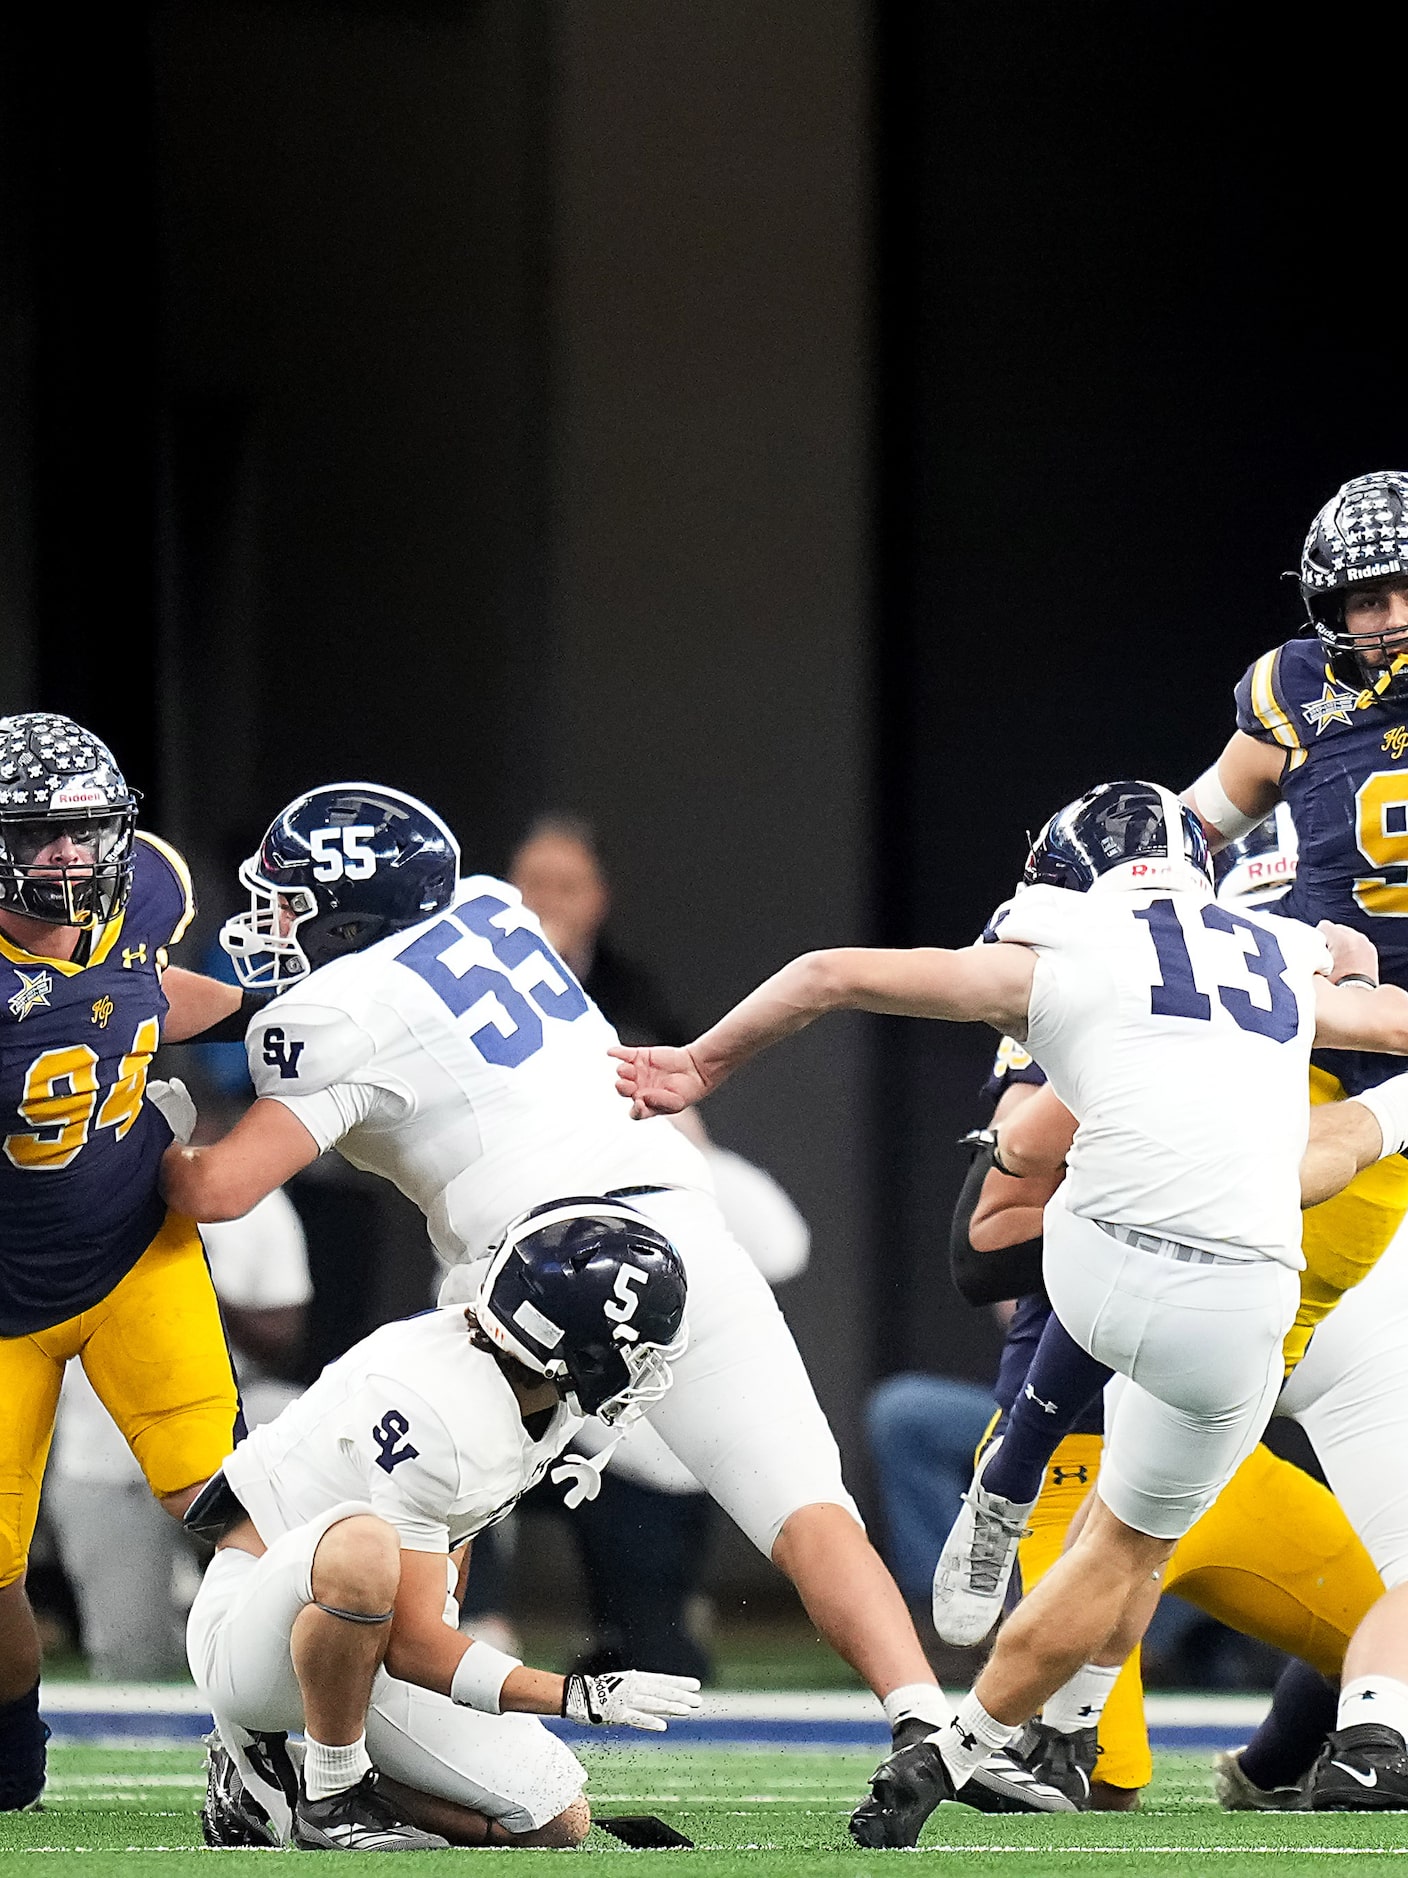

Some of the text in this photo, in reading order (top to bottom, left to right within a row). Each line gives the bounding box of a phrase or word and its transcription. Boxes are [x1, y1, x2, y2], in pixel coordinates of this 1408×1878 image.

[1347, 560, 1400, 581] Riddell
[59, 793, 101, 804] Riddell
[310, 825, 377, 882] 55
[393, 894, 589, 1069] 55
[1131, 898, 1299, 1044] 13
[91, 995, 114, 1028] HP
[263, 1027, 304, 1079] SV
[2, 1015, 160, 1170] 94
[603, 1262, 649, 1323] 5
[371, 1409, 420, 1475] SV
